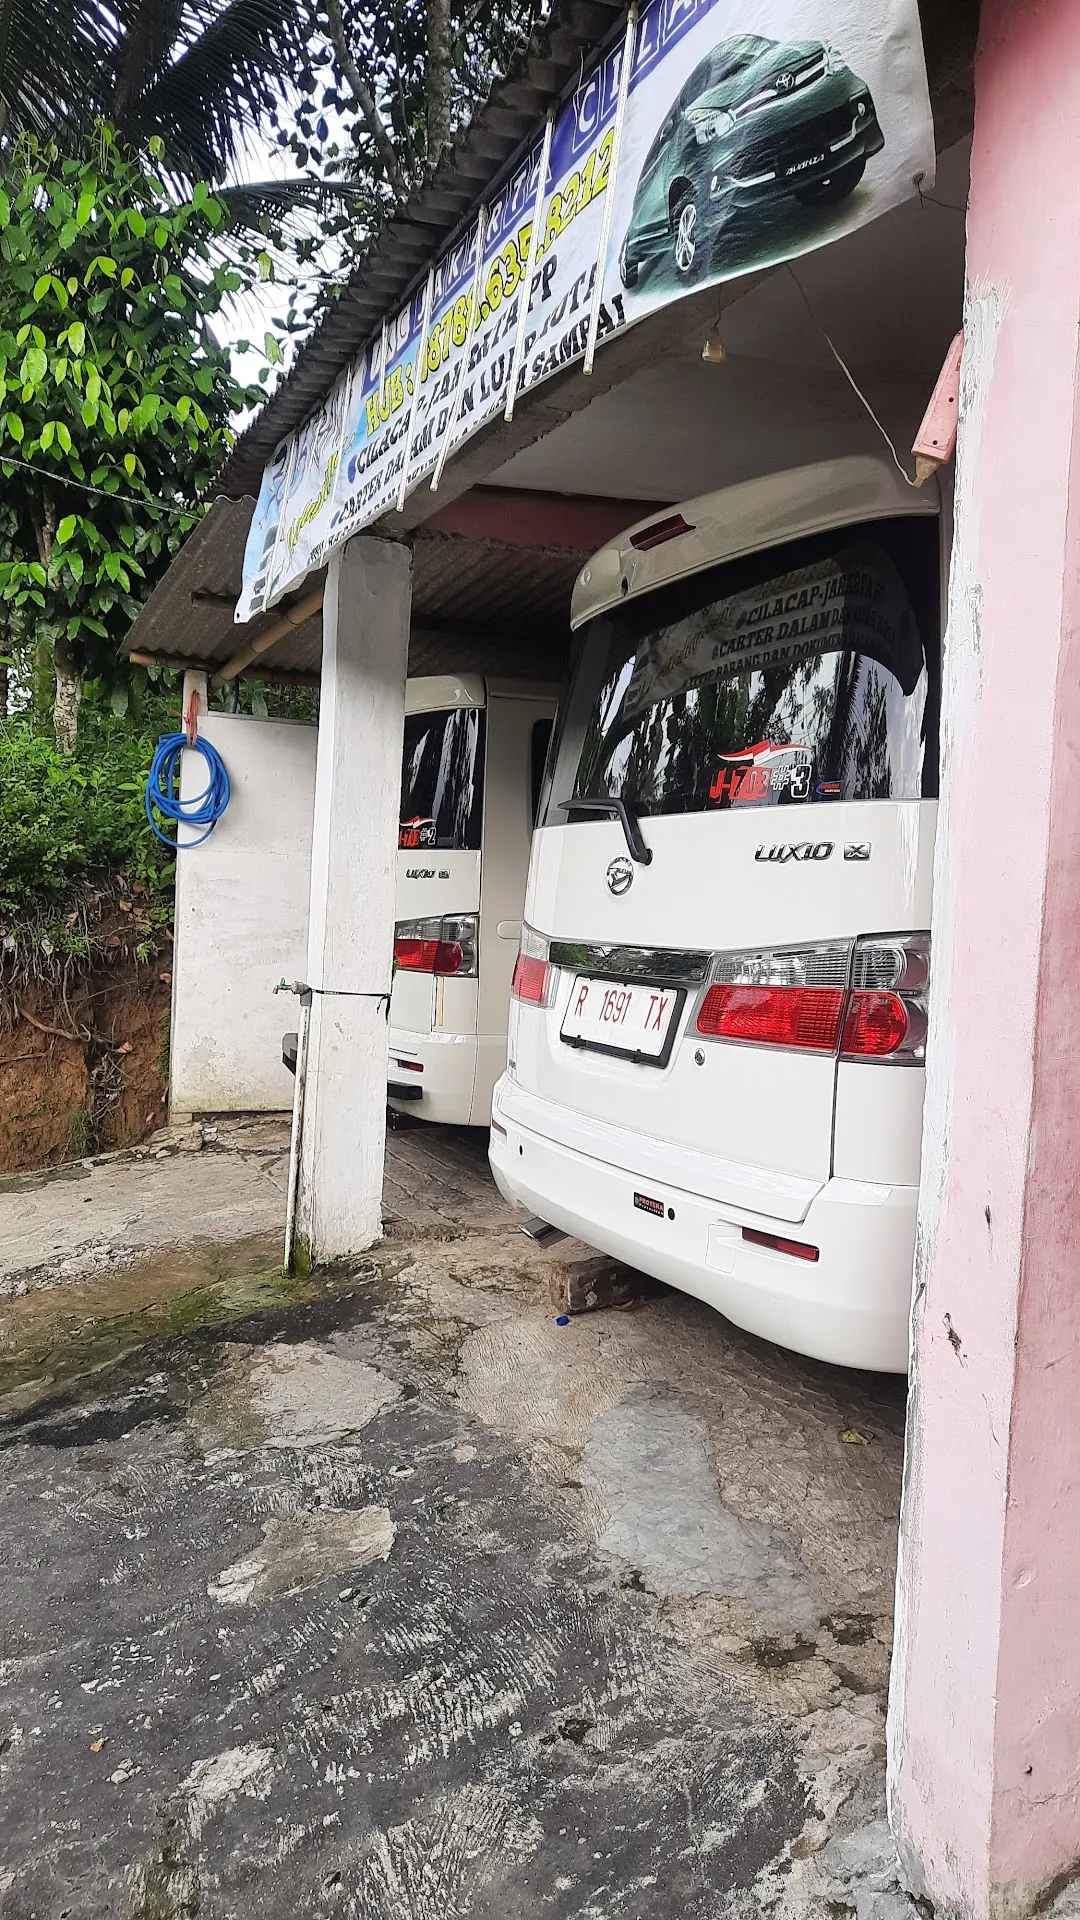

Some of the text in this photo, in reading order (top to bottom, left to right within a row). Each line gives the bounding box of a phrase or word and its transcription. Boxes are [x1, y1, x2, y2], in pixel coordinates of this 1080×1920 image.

[578, 0, 706, 133] CILA
[530, 293, 627, 385] SAMPAI
[338, 469, 383, 525] CARTER
[384, 416, 435, 486] DAAM
[719, 625, 774, 658] CARTER
[776, 609, 831, 641] DALAM
[754, 842, 871, 864] LUXIO X
[574, 985, 669, 1031] R 1691 TX
